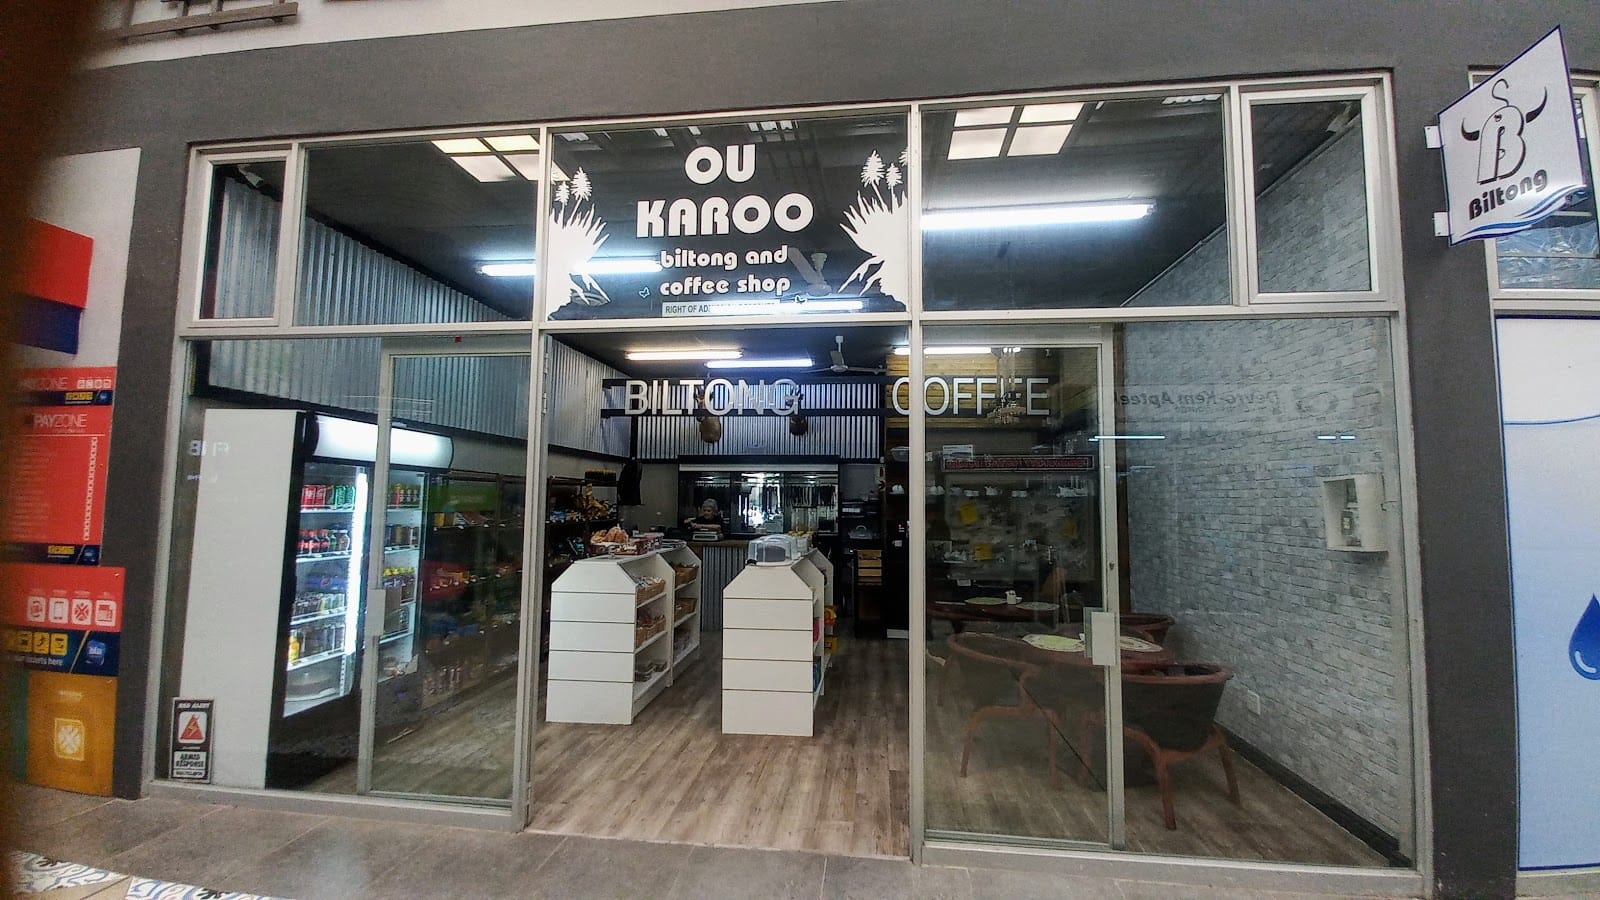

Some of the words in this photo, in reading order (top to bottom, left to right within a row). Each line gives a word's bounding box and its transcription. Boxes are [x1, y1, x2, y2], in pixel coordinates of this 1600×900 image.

[684, 144, 756, 185] OU
[1469, 169, 1548, 220] Biltong
[636, 192, 814, 238] KAROO
[660, 248, 738, 271] biltong
[745, 244, 789, 265] and
[659, 276, 729, 296] coffee
[736, 273, 791, 296] shop
[665, 305, 686, 314] RIGHT
[687, 305, 697, 313] OF
[624, 378, 800, 416] BILTONG
